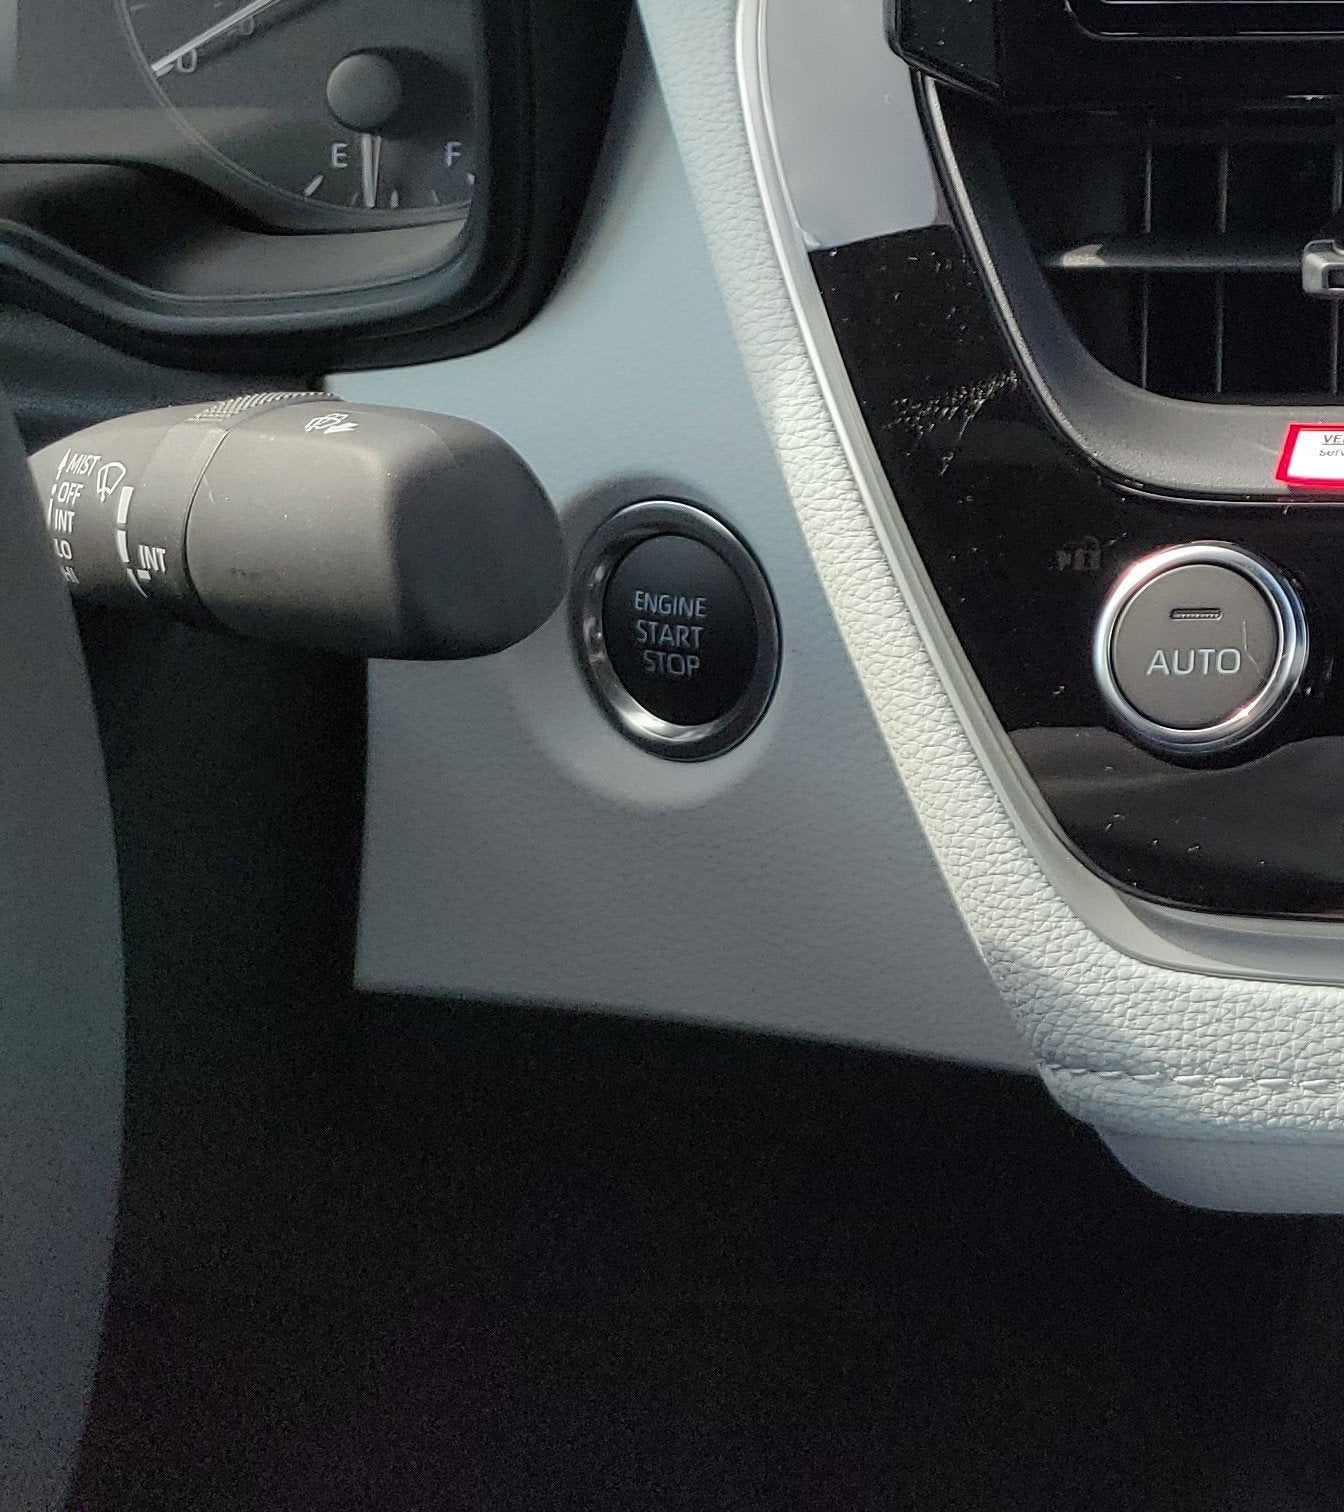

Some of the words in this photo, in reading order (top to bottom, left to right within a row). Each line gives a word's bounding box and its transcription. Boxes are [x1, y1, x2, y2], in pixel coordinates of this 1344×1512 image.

[177, 48, 198, 74] 0
[331, 144, 347, 168] E
[445, 143, 461, 166] F
[66, 453, 101, 477] MIST
[57, 481, 84, 506] OFF
[54, 509, 75, 533] INT
[54, 538, 73, 560] LO
[138, 544, 166, 573] INT
[62, 566, 80, 585] HI
[635, 590, 708, 617] ENGINE
[636, 620, 704, 649] START
[643, 650, 701, 676] STOP
[1146, 648, 1242, 676] AUTO
